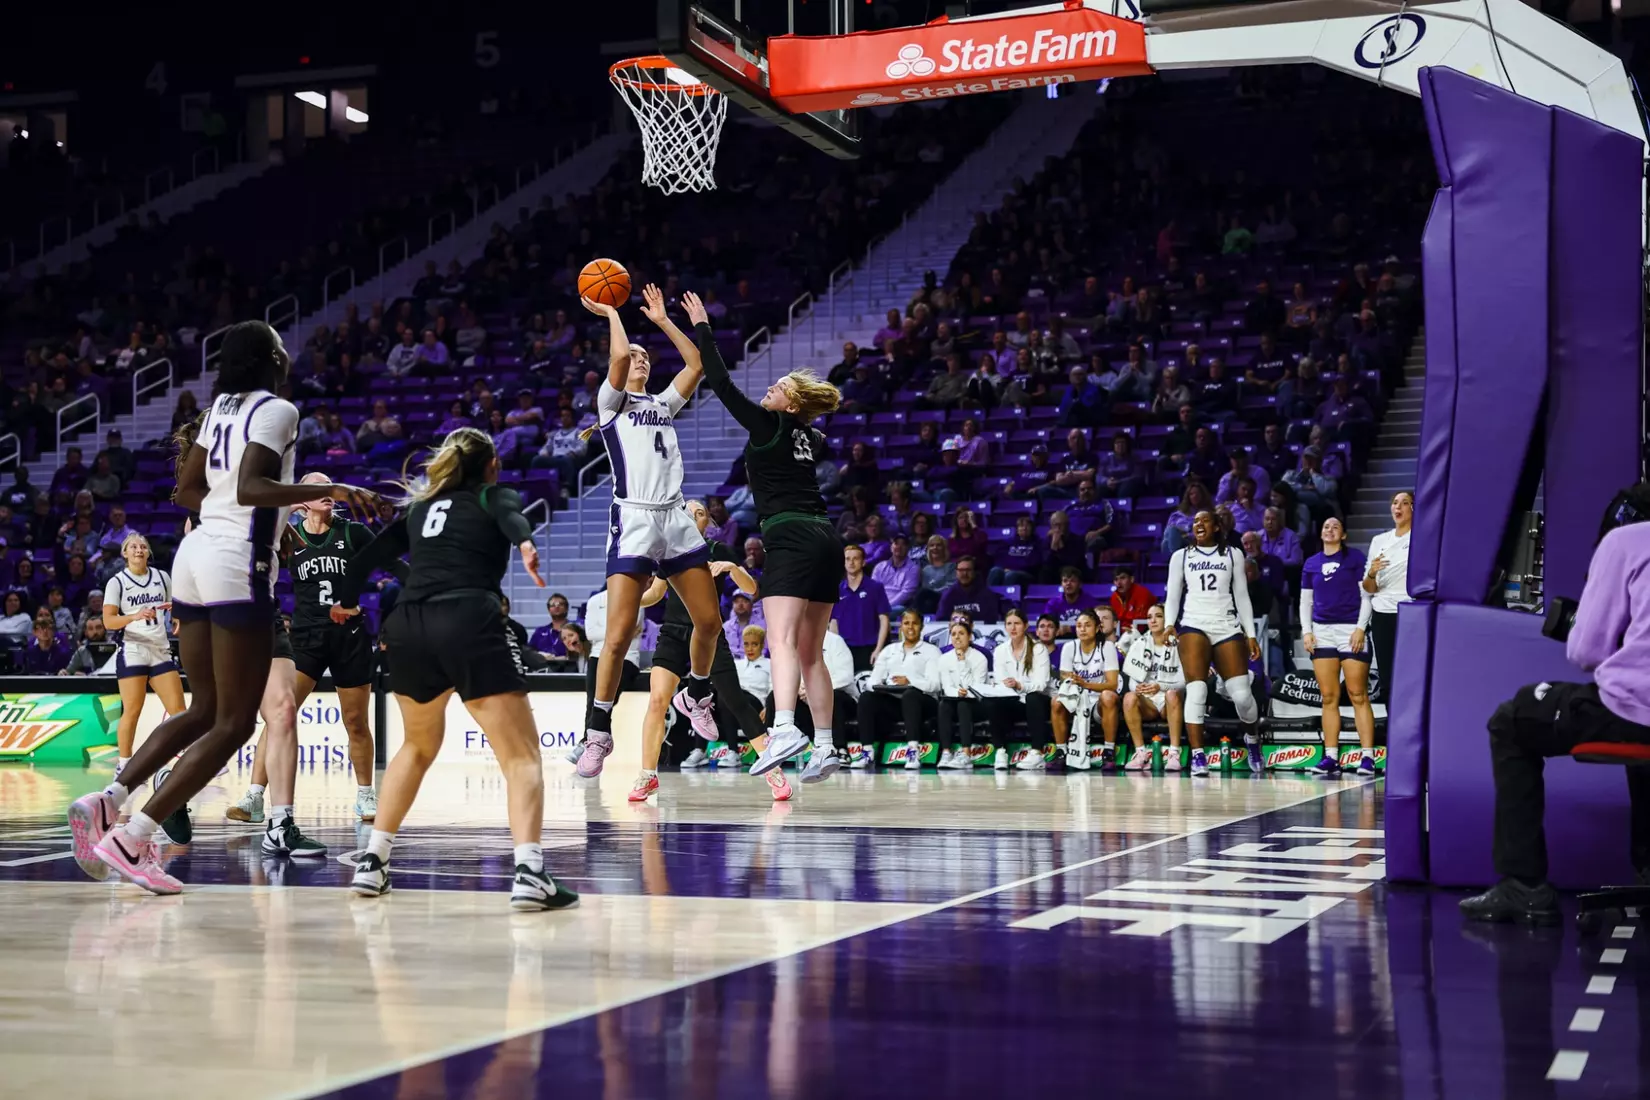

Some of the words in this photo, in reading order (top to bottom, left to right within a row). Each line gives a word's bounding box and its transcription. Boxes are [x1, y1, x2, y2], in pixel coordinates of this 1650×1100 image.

[475, 30, 501, 68] 5
[628, 410, 672, 427] Wildca
[210, 423, 233, 471] 21
[654, 431, 668, 460] 4
[791, 429, 815, 461] 33
[421, 498, 453, 538] 6
[298, 556, 347, 581] UPSTATE
[1188, 561, 1228, 572] Wildcats
[319, 580, 334, 606] 2
[1199, 573, 1217, 591] 12
[127, 593, 164, 606] Wildcats
[1284, 673, 1321, 690] Capit
[1267, 748, 1311, 766] LIBMAN
